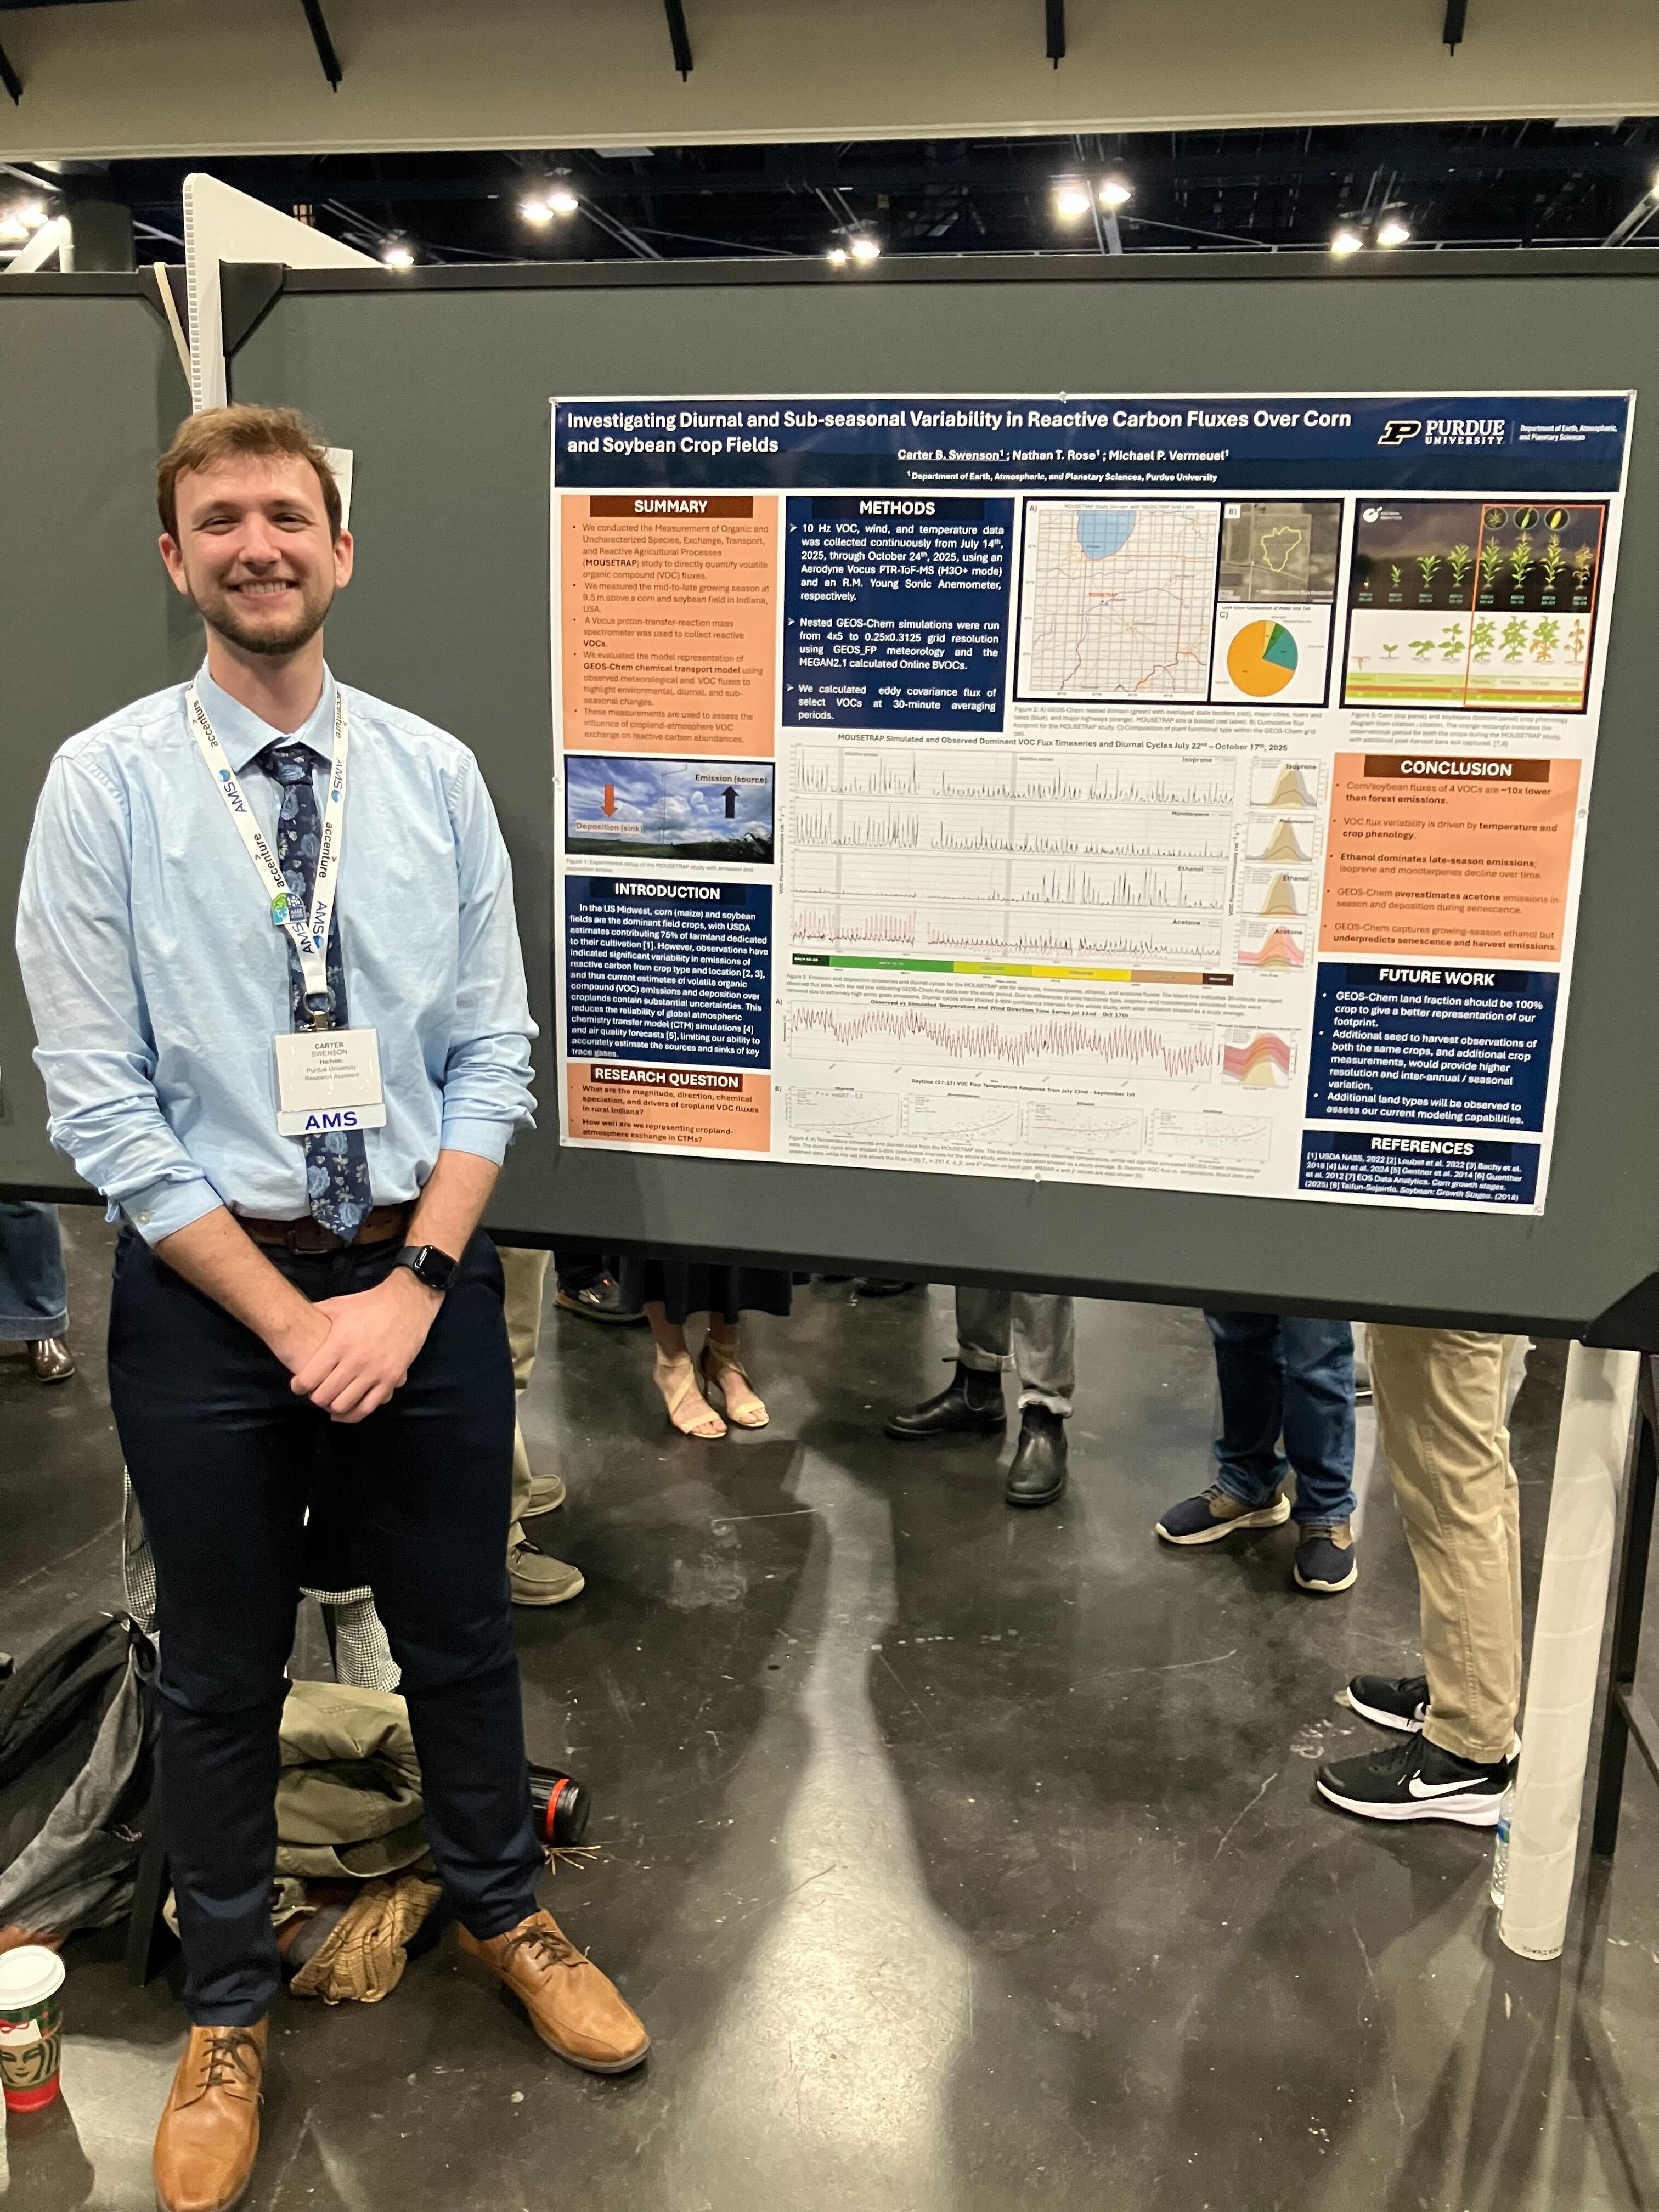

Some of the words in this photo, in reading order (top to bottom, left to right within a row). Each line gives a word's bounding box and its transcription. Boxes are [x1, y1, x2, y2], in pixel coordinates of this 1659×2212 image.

[568, 412, 676, 431] Investigating
[680, 411, 743, 427] Diurnal
[747, 411, 779, 427] and
[783, 411, 906, 427] Sub-seasonal
[909, 410, 1002, 430] Variability
[1006, 410, 1023, 427] in
[1028, 411, 1108, 427] Reactive
[1112, 410, 1182, 427] Carbon
[1187, 410, 1249, 427] Fluxes
[1253, 410, 1300, 427] Over
[1303, 410, 1351, 427] Corn
[1425, 420, 1505, 436] PURDUE
[567, 437, 599, 452] and
[602, 437, 676, 455] Soybean
[680, 437, 722, 455] Crop
[726, 436, 778, 452] Fields
[1425, 437, 1503, 445] UNIVERSITY
[898, 449, 933, 461] Carter
[935, 450, 946, 460] B.
[1012, 450, 1053, 461] Nathan
[1054, 450, 1065, 460] T.
[1108, 450, 1155, 460] Michael
[1156, 450, 1167, 460] P.
[969, 472, 994, 482] Earth,
[994, 472, 1047, 481] Atmospheric,
[1065, 472, 1104, 482] Planetary
[1104, 473, 1144, 481] Sciences,
[1146, 472, 1175, 481] Purdue
[1176, 473, 1217, 482] University
[633, 499, 708, 514] SUMMARY
[859, 500, 935, 515] METHODS
[803, 523, 814, 532] 10
[819, 523, 831, 533] Hz
[836, 523, 860, 534] VOC,
[865, 524, 890, 534] wind,
[895, 524, 914, 533] and
[919, 525, 978, 535] temperature
[983, 526, 1004, 534] data
[823, 537, 867, 546] collected
[870, 538, 932, 549] continuously
[934, 538, 957, 548] from
[960, 539, 979, 550] July
[801, 550, 826, 560] 2025,
[829, 551, 865, 562] through
[867, 551, 907, 561] October
[933, 552, 959, 562] 2025,
[962, 552, 988, 563] using
[800, 564, 844, 575] Aerodyne
[847, 564, 876, 574] Vocus
[879, 565, 934, 574] PTR-ToF-MS
[971, 566, 1002, 577] mode)
[1219, 611, 1229, 619] C)
[583, 663, 634, 672] GEOS-Chem
[635, 663, 673, 673] chemical
[674, 665, 713, 674] transport
[742, 667, 764, 676] using
[194, 699, 218, 747] accenture
[1146, 741, 1172, 749] Cycles
[1173, 742, 1189, 750] July
[334, 758, 343, 790] AMS
[1400, 760, 1512, 776] CONCLUSION
[695, 774, 732, 782] Emission
[733, 775, 768, 785] (source)
[224, 782, 247, 812] AMS
[576, 822, 619, 832] Deposition
[620, 823, 644, 833] (sink)
[319, 822, 333, 878] accenture
[254, 833, 285, 888] accenture
[1340, 853, 1375, 861] Ethanol
[1377, 854, 1426, 862] dominates
[1429, 856, 1484, 865] late-season
[615, 883, 720, 899] INTRODUCTION
[313, 901, 328, 934] AMS
[603, 905, 616, 913] US
[617, 905, 653, 916] Midwest,
[674, 909, 703, 919] (maize)
[721, 912, 755, 921] soybean
[292, 922, 314, 955] AMS
[1379, 968, 1442, 983] FUTURE
[1444, 971, 1495, 986] WORK
[1336, 991, 1398, 1002] GEOS-Chem
[1400, 994, 1421, 1003] land
[1424, 995, 1462, 1005] fraction
[1463, 997, 1498, 1007] should
[1499, 999, 1513, 1008] be
[1515, 1000, 1543, 1009] 100%
[1334, 1005, 1357, 1015] crop
[1358, 1005, 1369, 1014] to
[1370, 1006, 1390, 1016] give
[1400, 1007, 1430, 1017] better
[1431, 1010, 1504, 1020] representation
[1505, 1012, 1517, 1021] of
[1334, 1017, 1378, 1027] footprint.
[311, 1048, 347, 1057] SWENSON
[595, 1068, 666, 1084] RESEARCH
[669, 1073, 739, 1088] QUESTION
[305, 1111, 359, 1130] AMS
[645, 1124, 694, 1133] representing
[1371, 1137, 1474, 1155] REFERENCES
